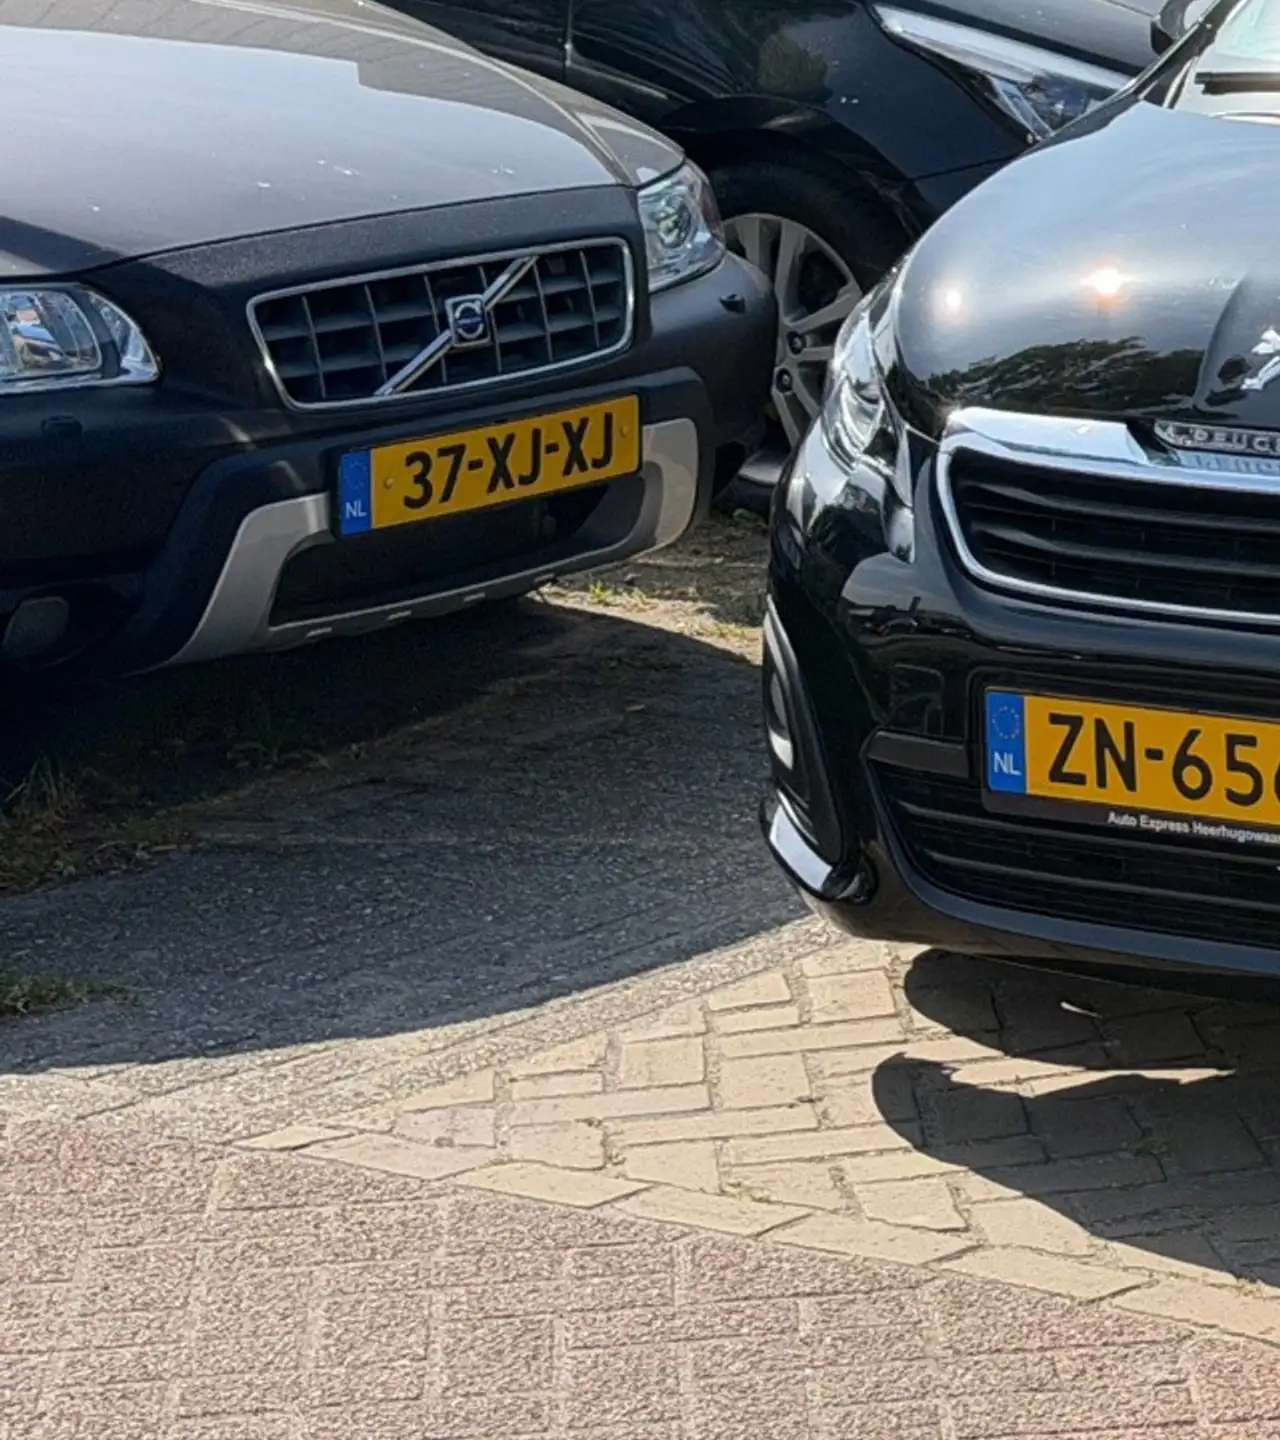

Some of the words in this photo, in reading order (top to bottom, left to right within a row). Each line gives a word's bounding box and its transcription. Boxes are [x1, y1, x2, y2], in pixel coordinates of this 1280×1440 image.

[403, 412, 613, 510] 37-XJ-XJ
[345, 500, 367, 519] NL
[992, 751, 1022, 777] NL
[1107, 811, 1137, 828] Auto
[1139, 814, 1191, 834] Express
